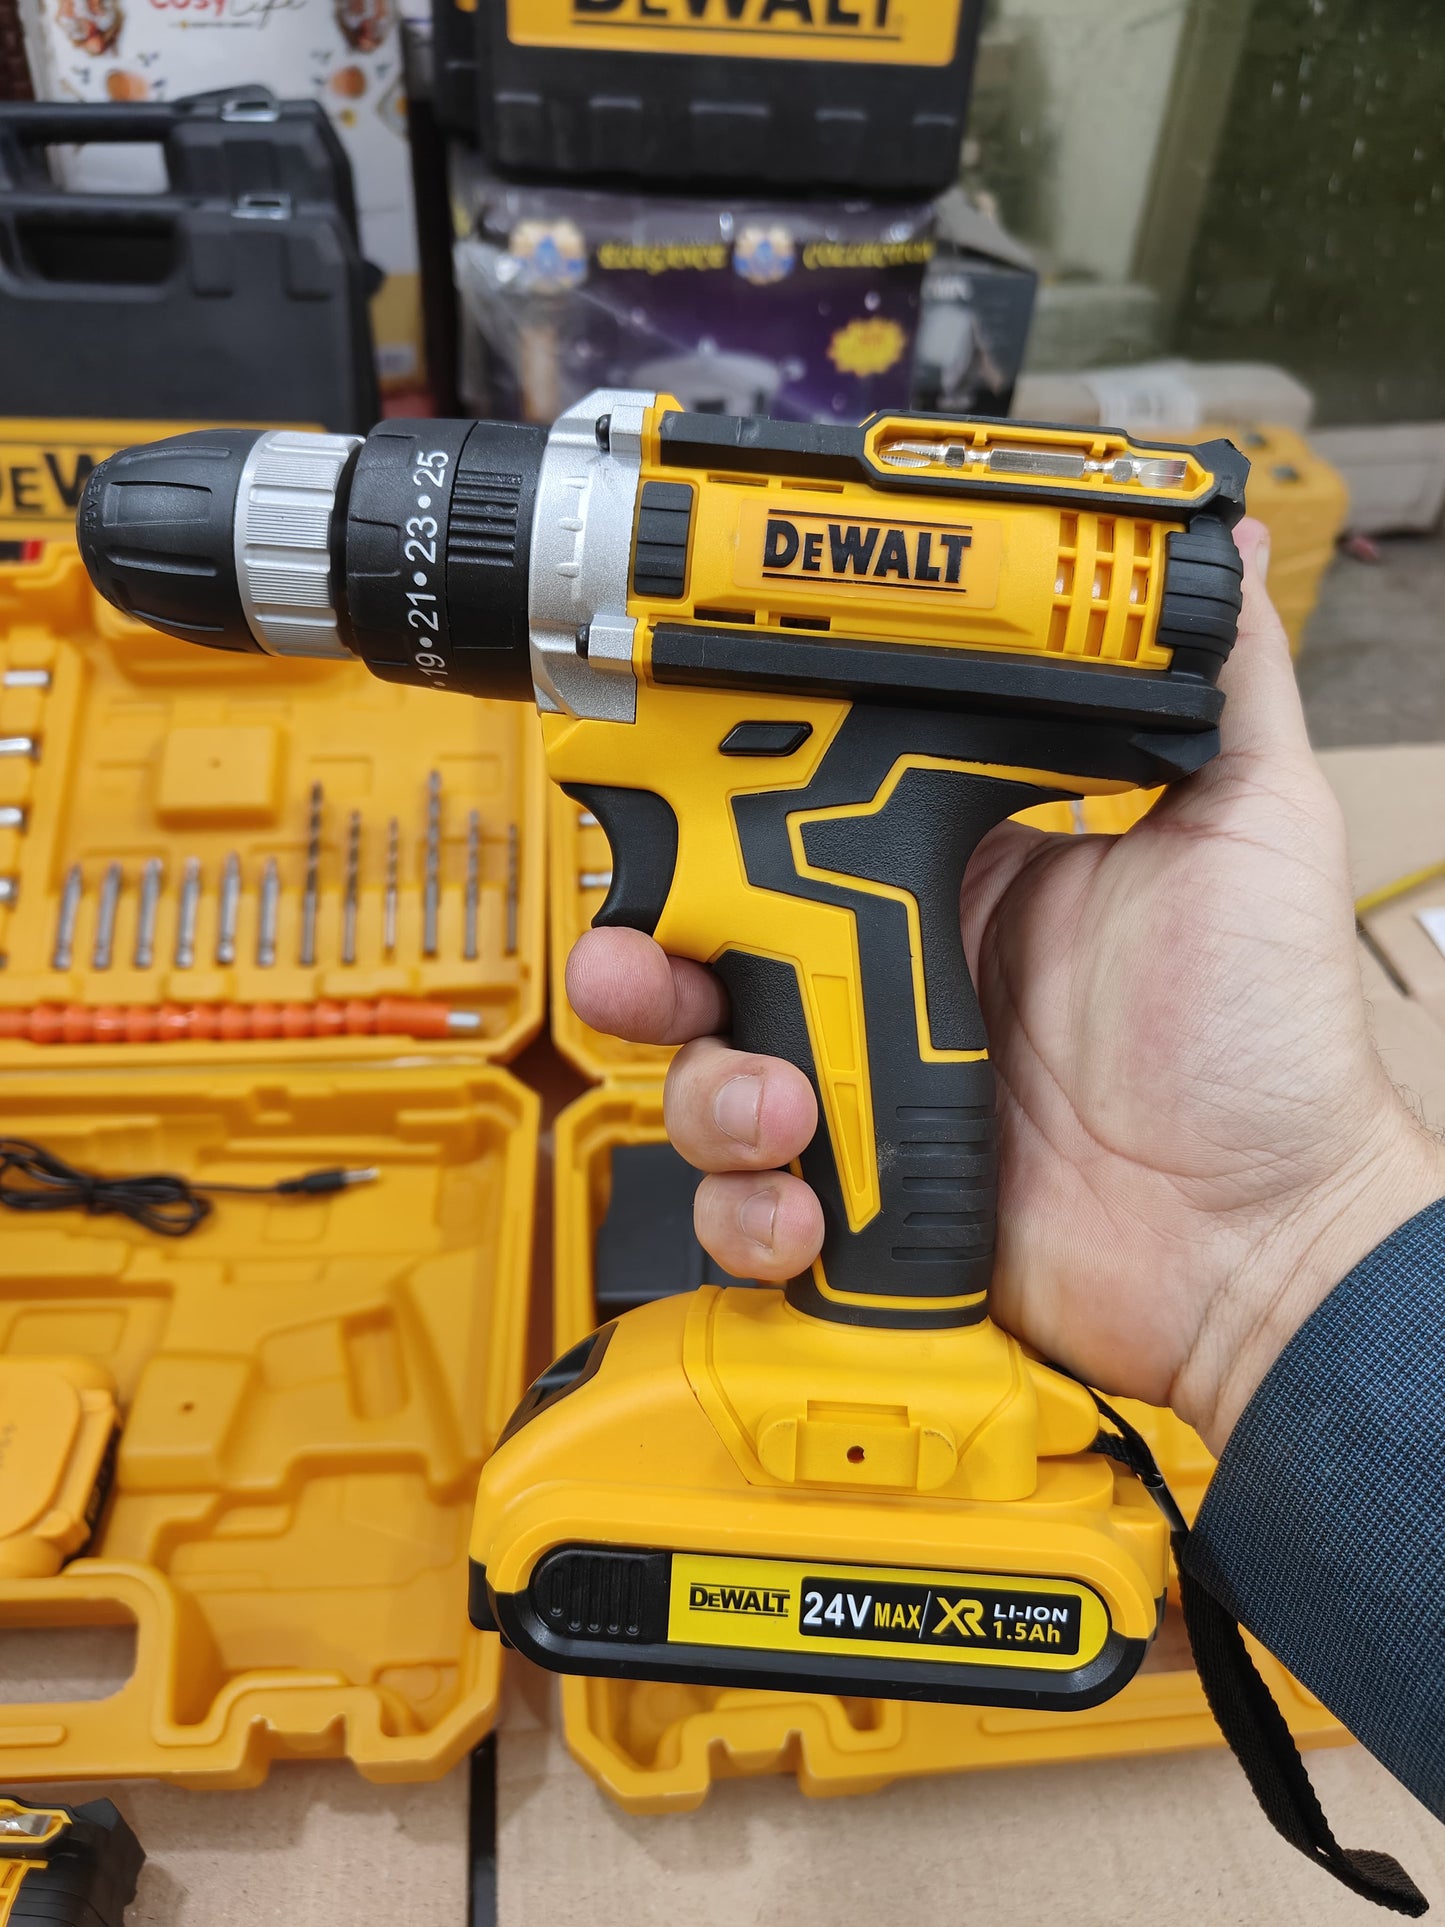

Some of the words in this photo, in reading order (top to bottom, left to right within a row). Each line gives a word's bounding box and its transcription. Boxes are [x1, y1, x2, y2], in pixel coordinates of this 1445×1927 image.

[413, 450, 449, 488] 25
[404, 516, 438, 564] 23
[405, 592, 439, 631] 21
[415, 653, 449, 677] 19
[803, 1591, 872, 1628] 24V
[874, 1602, 921, 1629] MAX
[931, 1597, 987, 1637] XR
[993, 1603, 1068, 1623] LI-ION
[993, 1620, 1061, 1644] 1.5Ah
